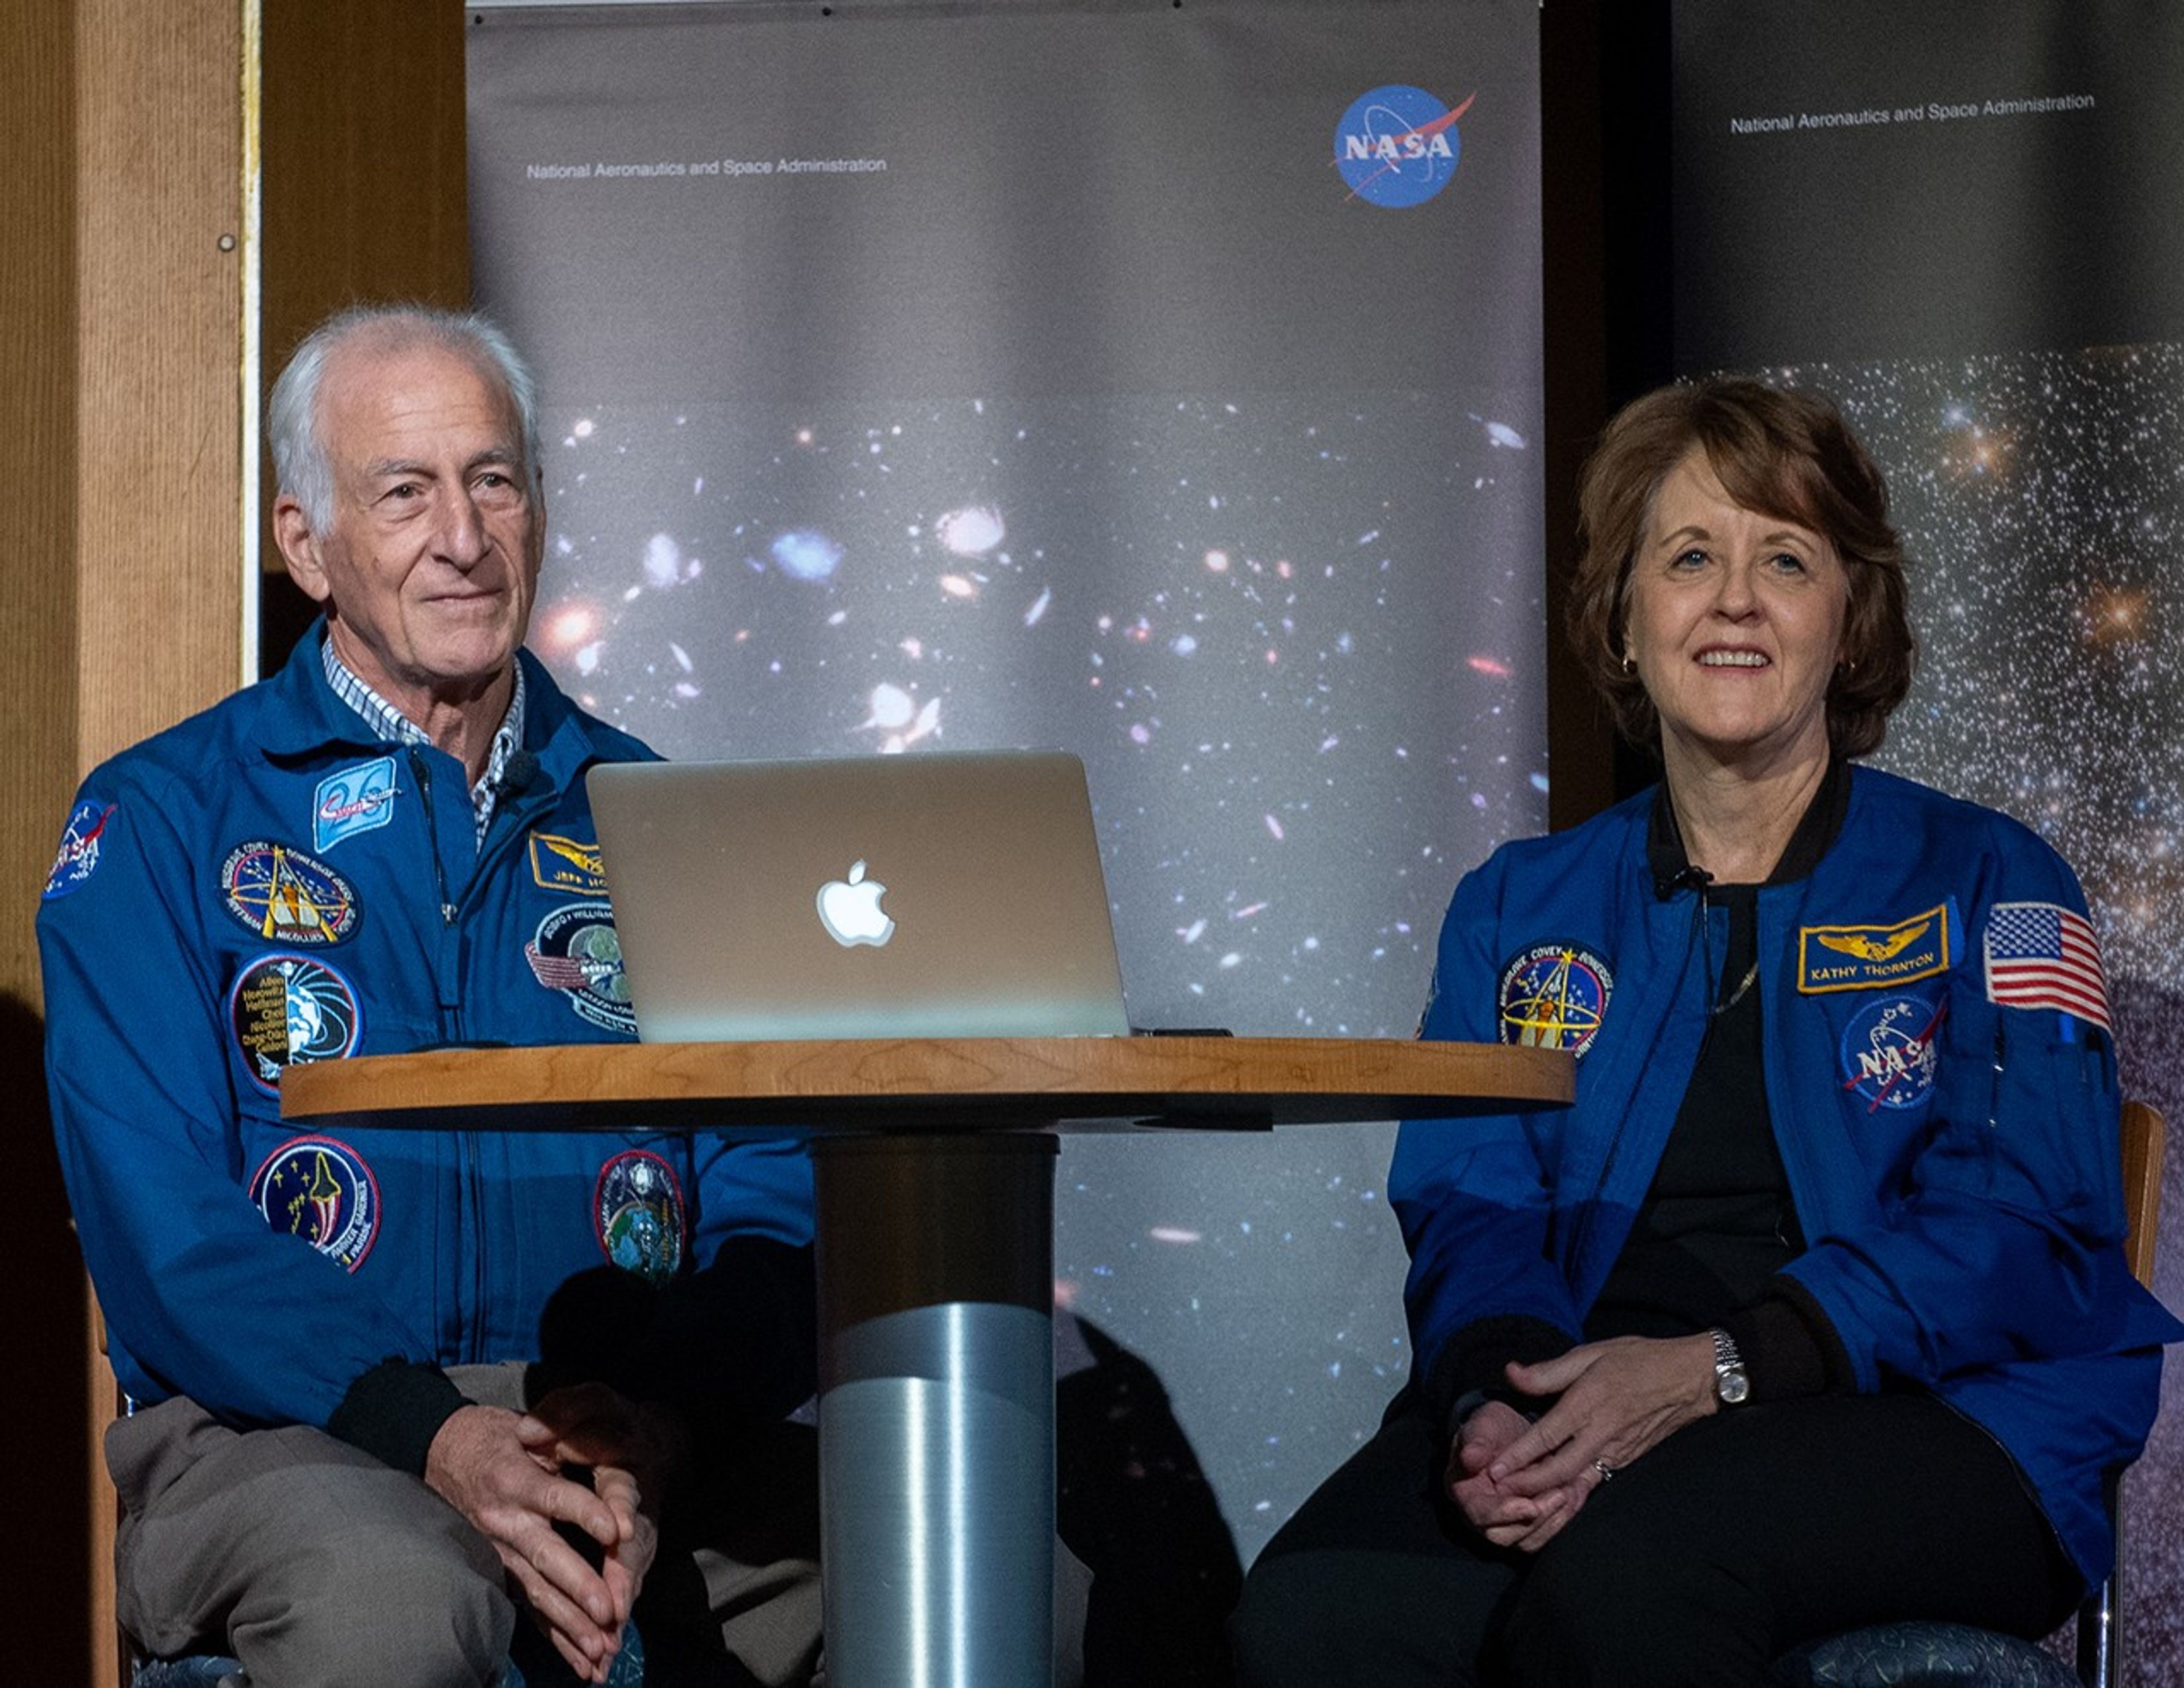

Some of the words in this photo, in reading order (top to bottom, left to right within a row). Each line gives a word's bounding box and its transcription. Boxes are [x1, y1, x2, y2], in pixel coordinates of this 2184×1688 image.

[1731, 113, 1794, 134] National
[1798, 108, 1889, 129] Aeronautics
[1893, 104, 1924, 122] and
[1927, 102, 1978, 122] Space
[1983, 93, 2095, 115] Administration
[1345, 133, 1453, 160] NASA
[527, 164, 590, 179] National
[595, 162, 686, 177] Aeronautics
[690, 160, 719, 175] and
[723, 159, 773, 177] Space
[776, 158, 887, 174] Administration
[1530, 945, 1563, 960] COVEY
[1810, 965, 1858, 980] KATHY
[1863, 952, 1934, 977] THORNTON
[1856, 1039, 1938, 1079] NASA
